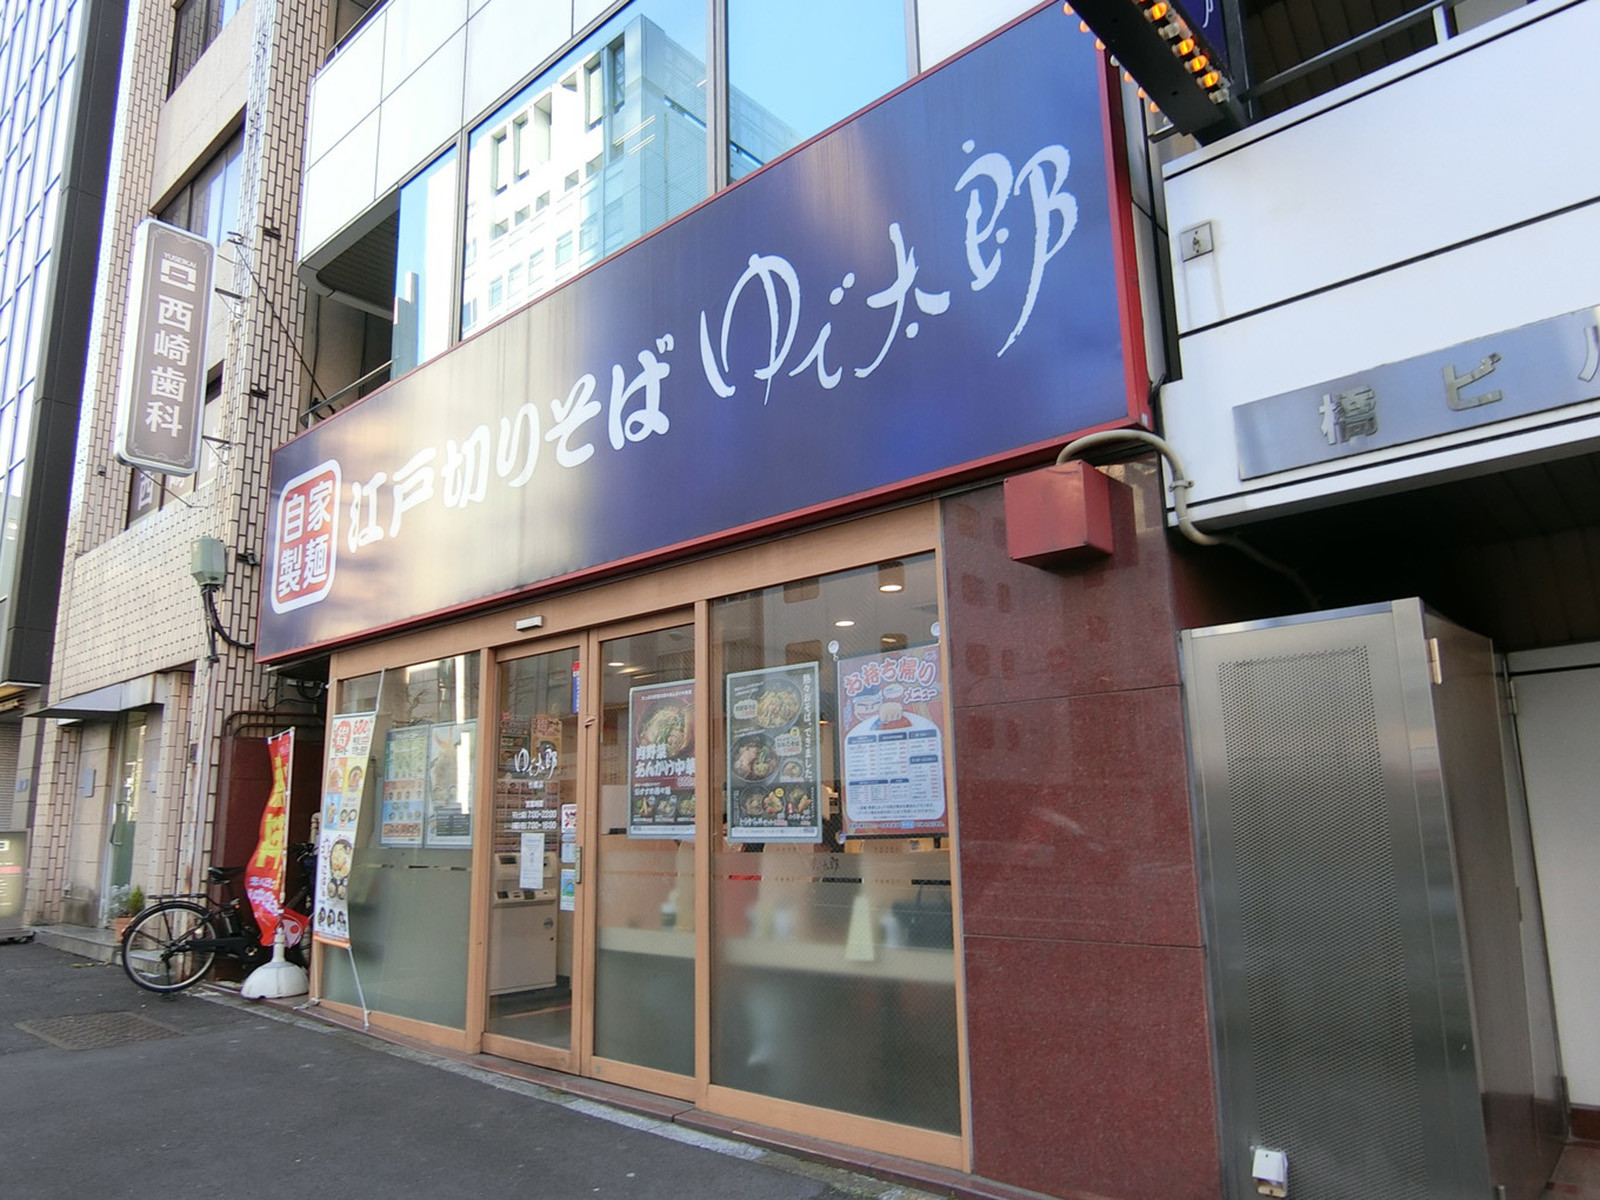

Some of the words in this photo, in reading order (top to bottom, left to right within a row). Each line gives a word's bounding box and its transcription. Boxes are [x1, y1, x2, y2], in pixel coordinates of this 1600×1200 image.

[145, 294, 195, 438] 西崎歯科
[347, 333, 675, 554] 江戸切りそば
[283, 481, 333, 543] 自家
[843, 656, 936, 696] お持ち帰り
[903, 687, 937, 704] メニュー
